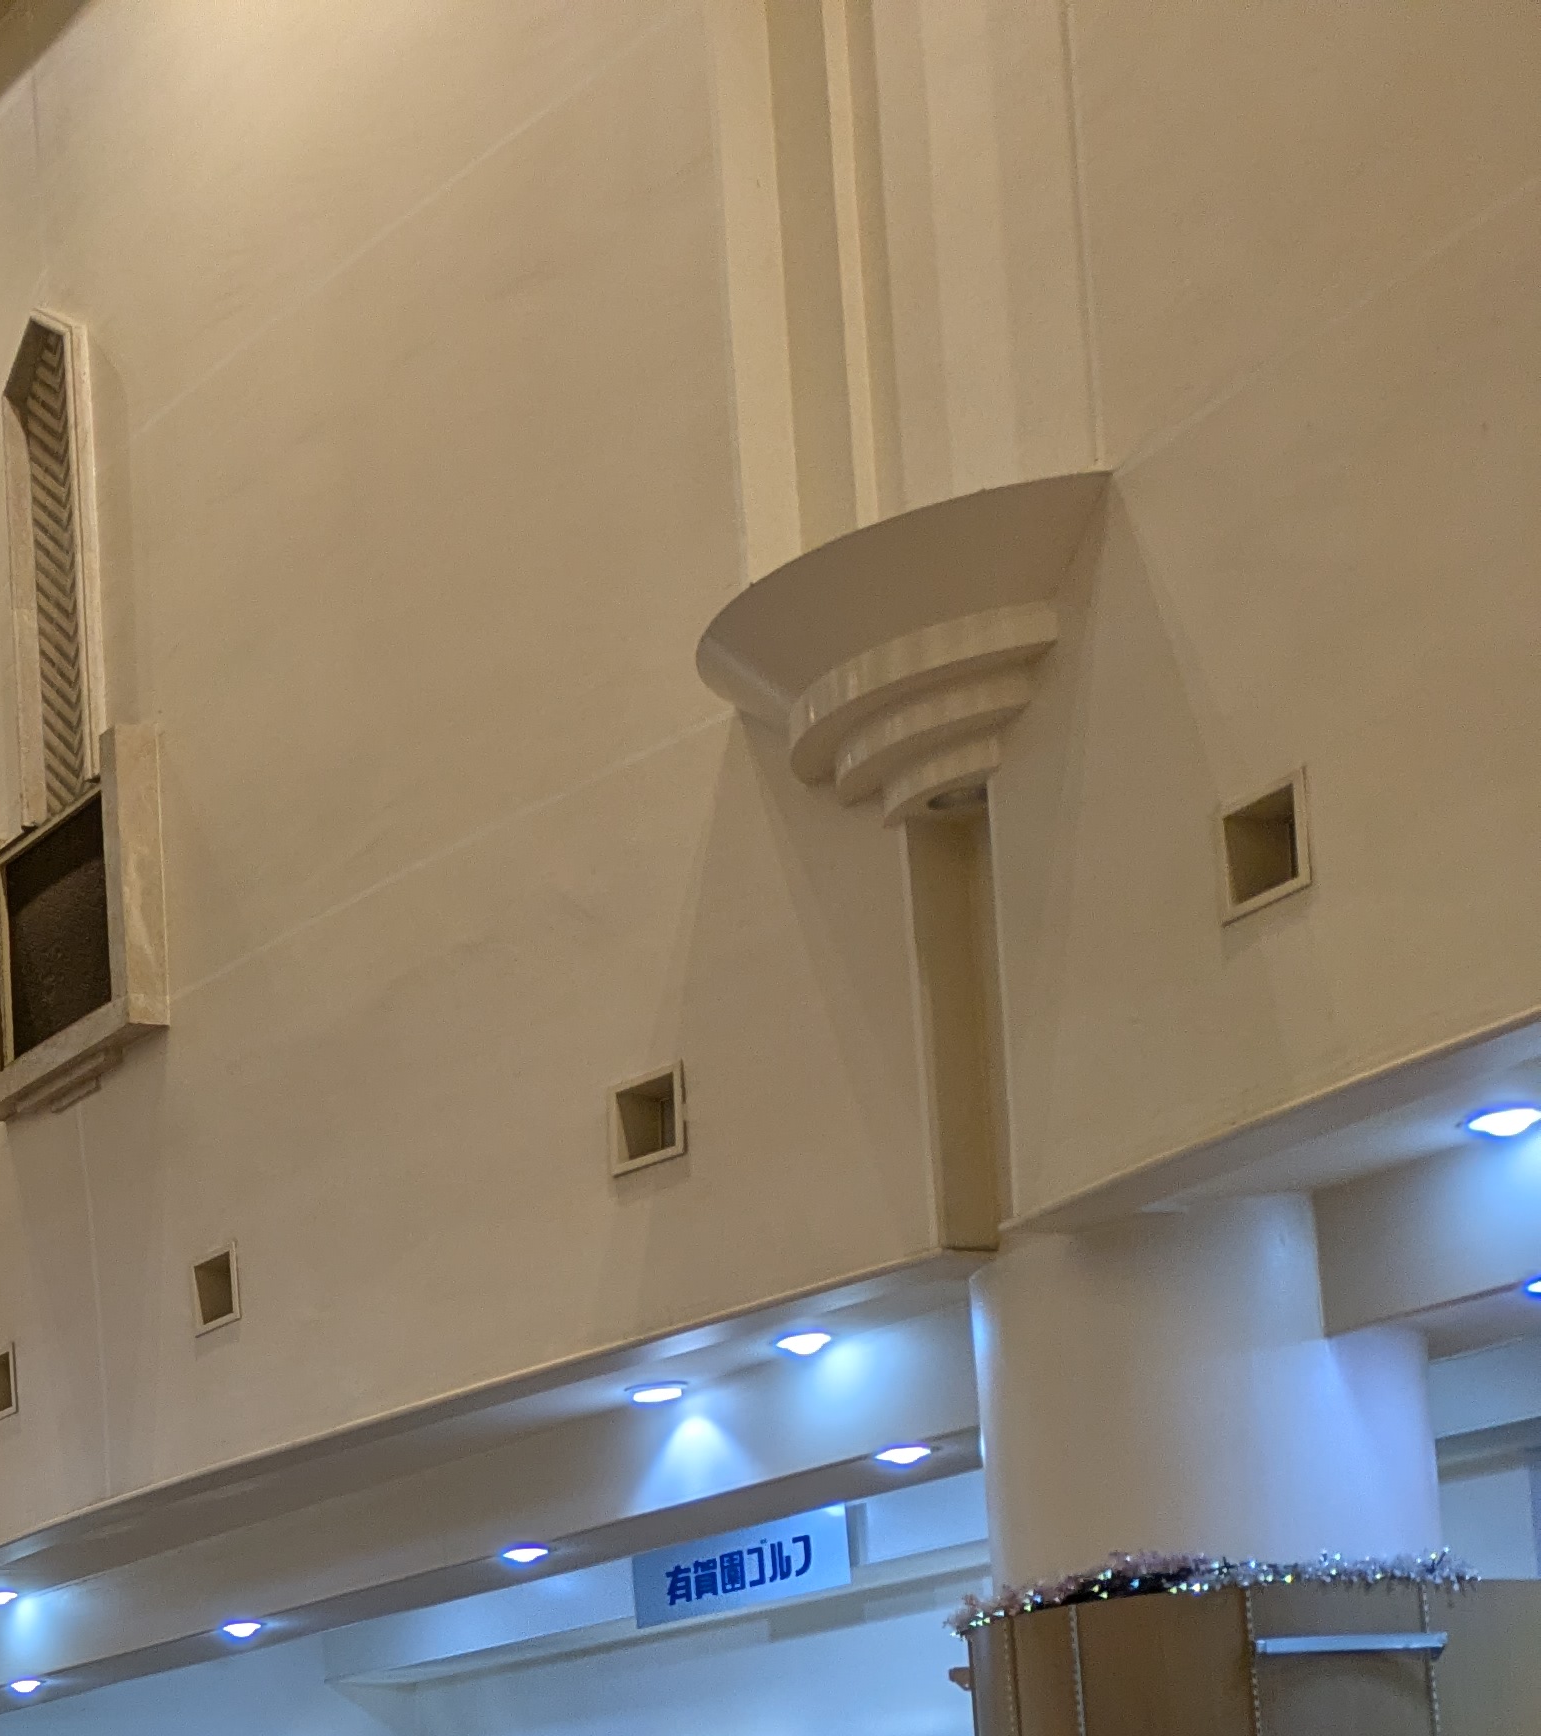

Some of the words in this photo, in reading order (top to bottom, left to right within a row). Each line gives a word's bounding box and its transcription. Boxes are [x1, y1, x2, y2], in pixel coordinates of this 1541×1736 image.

[665, 1534, 812, 1606] 有賀園ゴルフ
